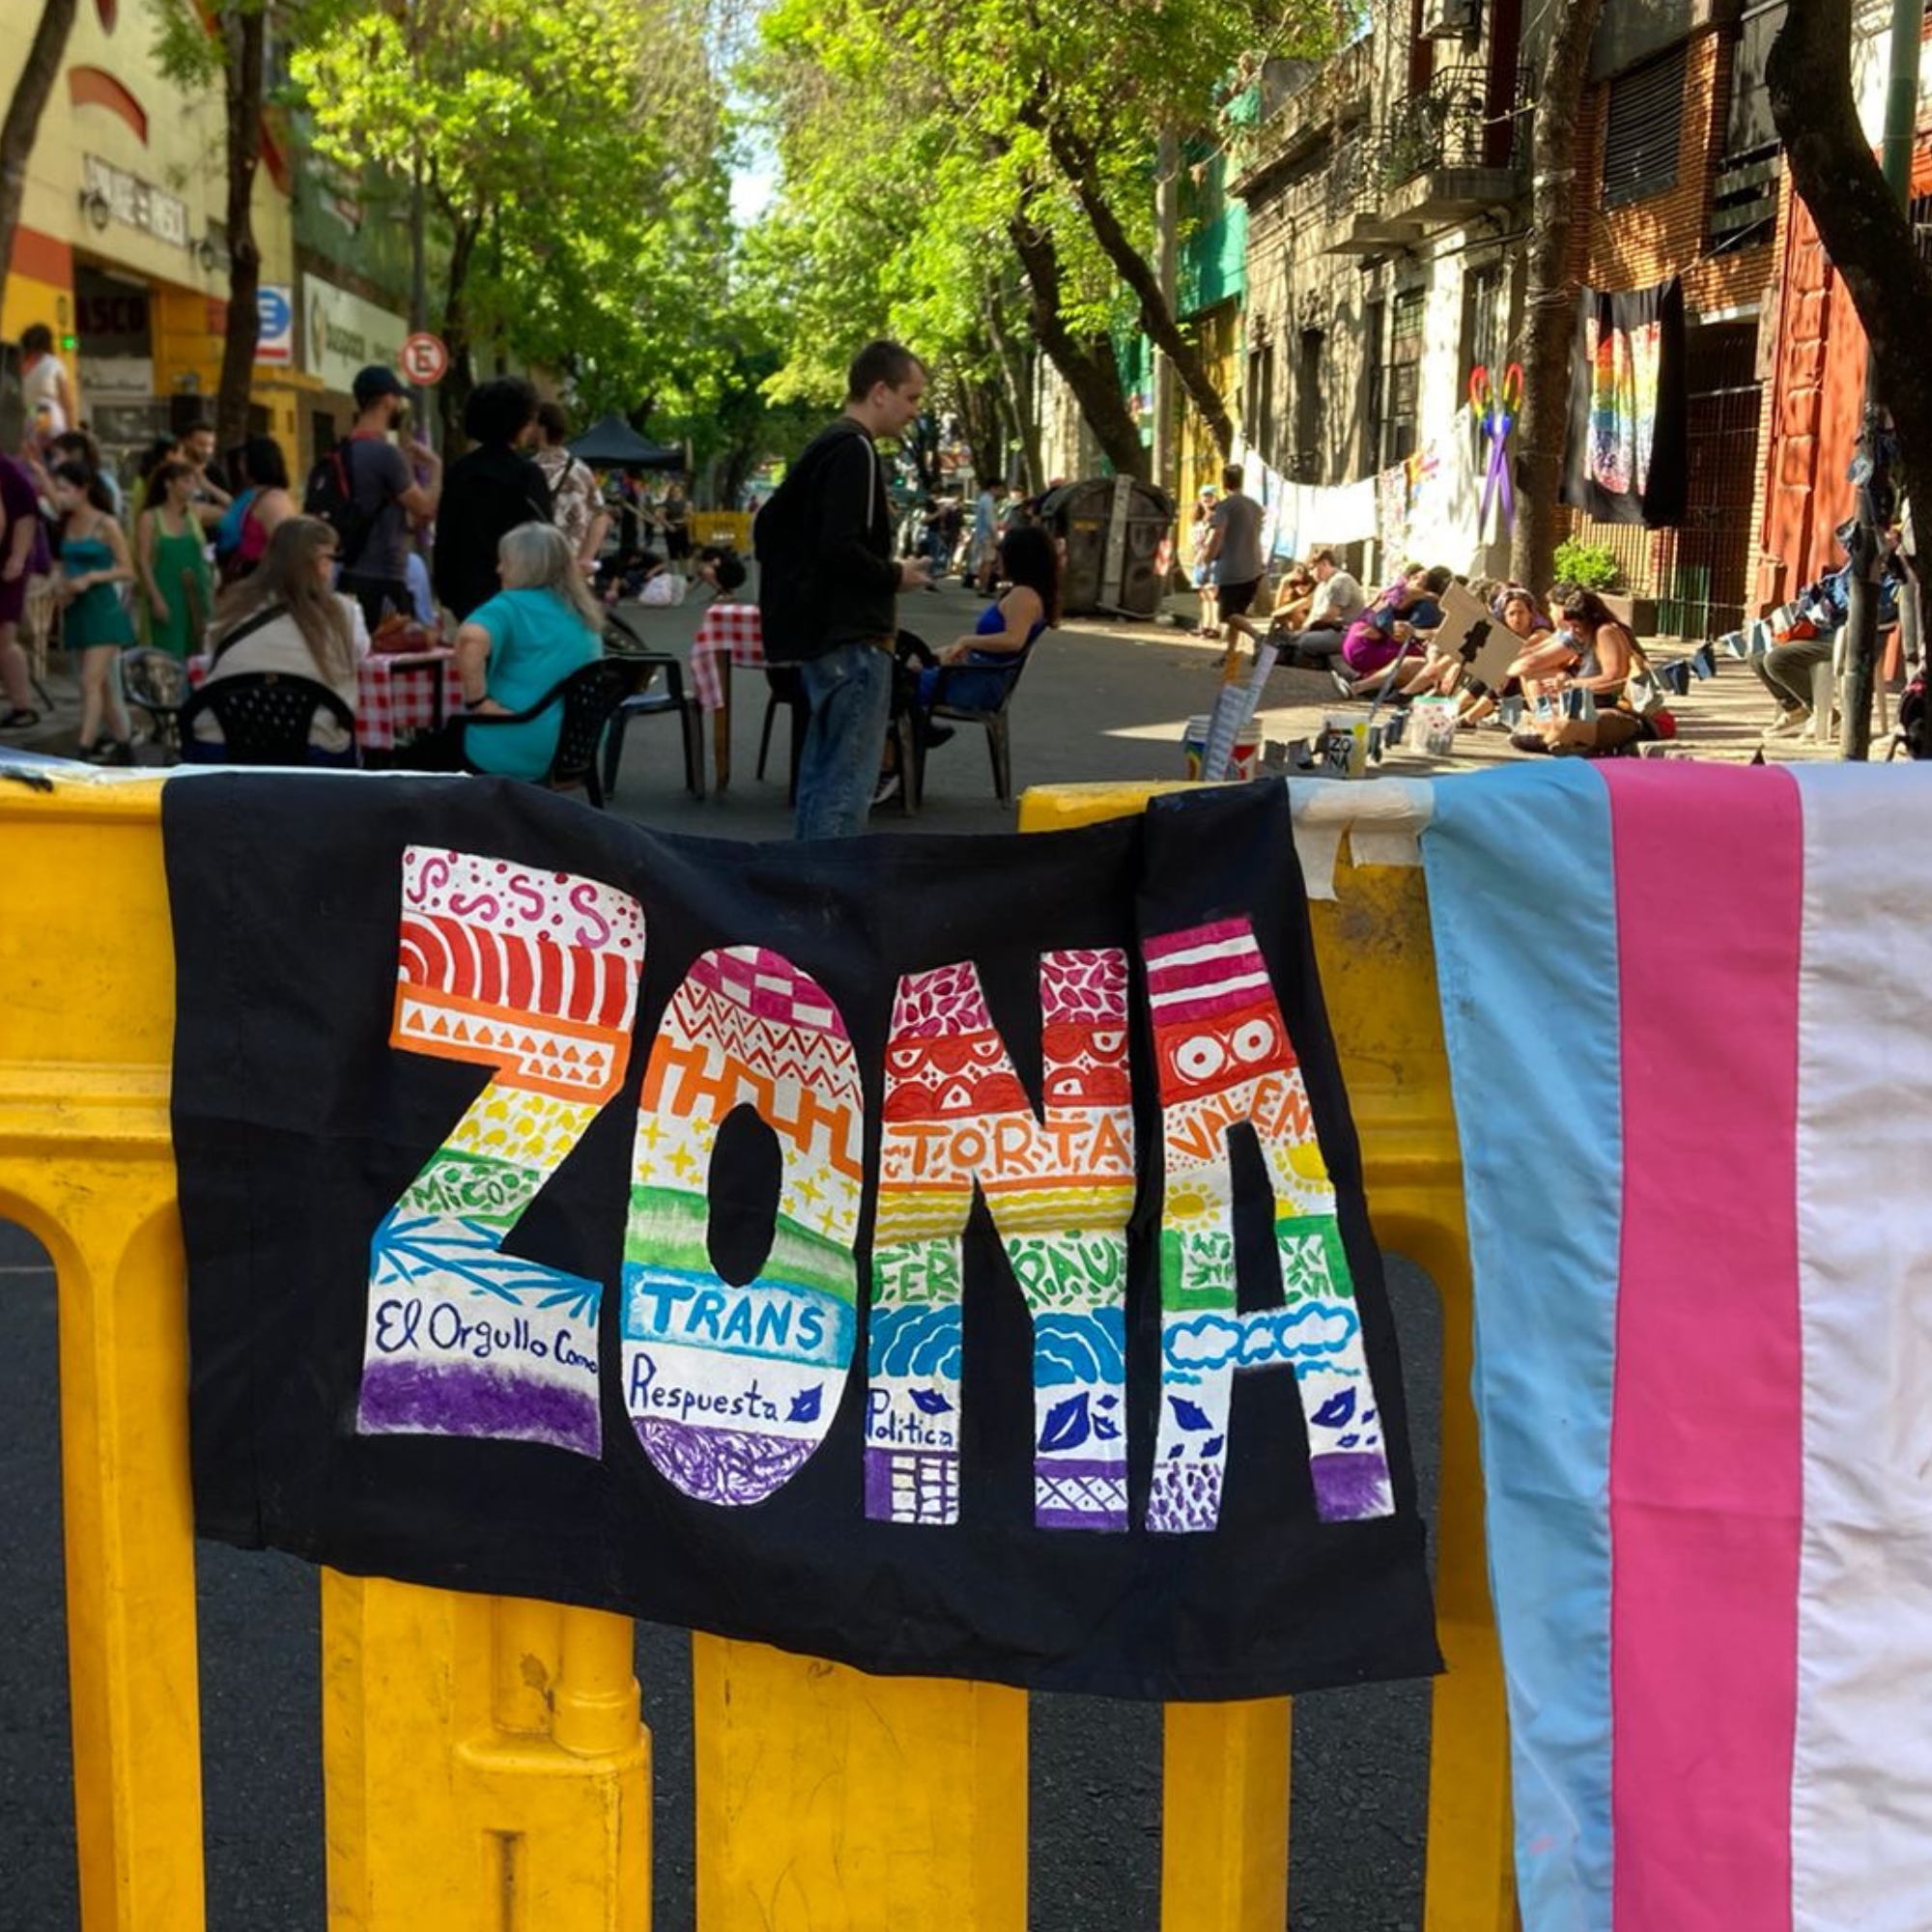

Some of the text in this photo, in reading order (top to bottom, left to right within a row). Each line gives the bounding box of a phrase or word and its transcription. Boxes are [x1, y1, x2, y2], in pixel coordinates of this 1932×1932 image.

[888, 1115, 1132, 1177] TORTA
[355, 845, 1395, 1534] ZONA
[871, 1250, 959, 1304] FER
[639, 1283, 826, 1351] TRANS
[375, 1298, 423, 1352] El
[429, 1301, 549, 1363] Orgullo
[629, 1352, 780, 1424] Respuesta
